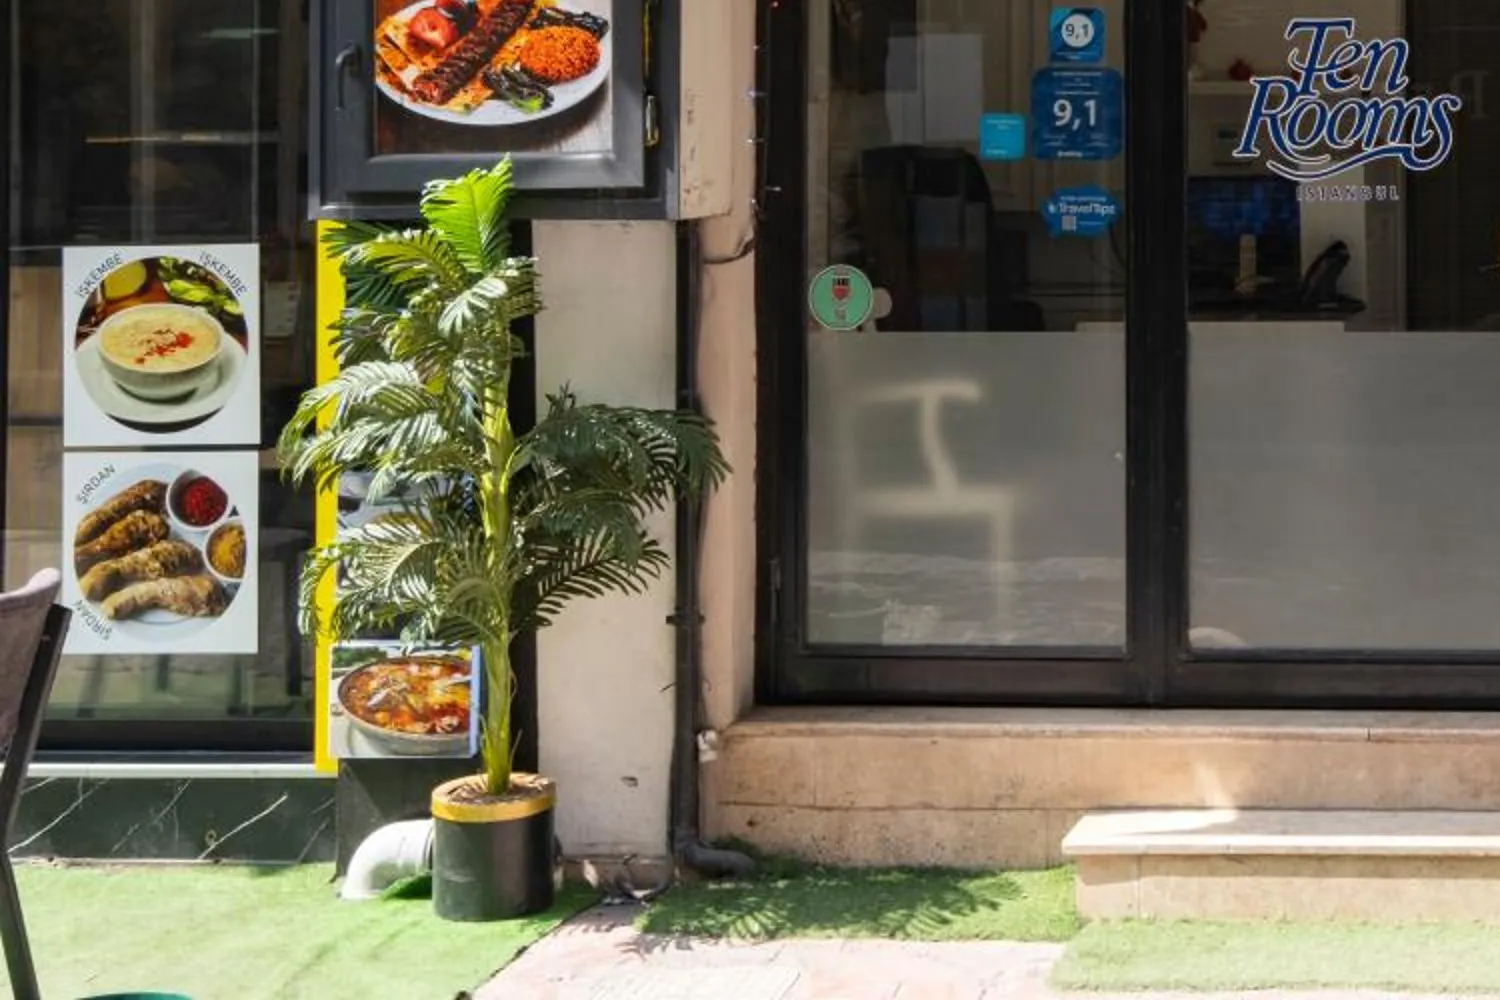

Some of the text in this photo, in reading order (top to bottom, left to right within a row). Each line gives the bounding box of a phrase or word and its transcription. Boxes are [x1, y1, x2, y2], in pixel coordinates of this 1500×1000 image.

[1065, 23, 1089, 40] 9,1
[1285, 17, 1410, 97] Ten
[1053, 99, 1097, 131] 9,1
[1233, 74, 1463, 181] Rooms
